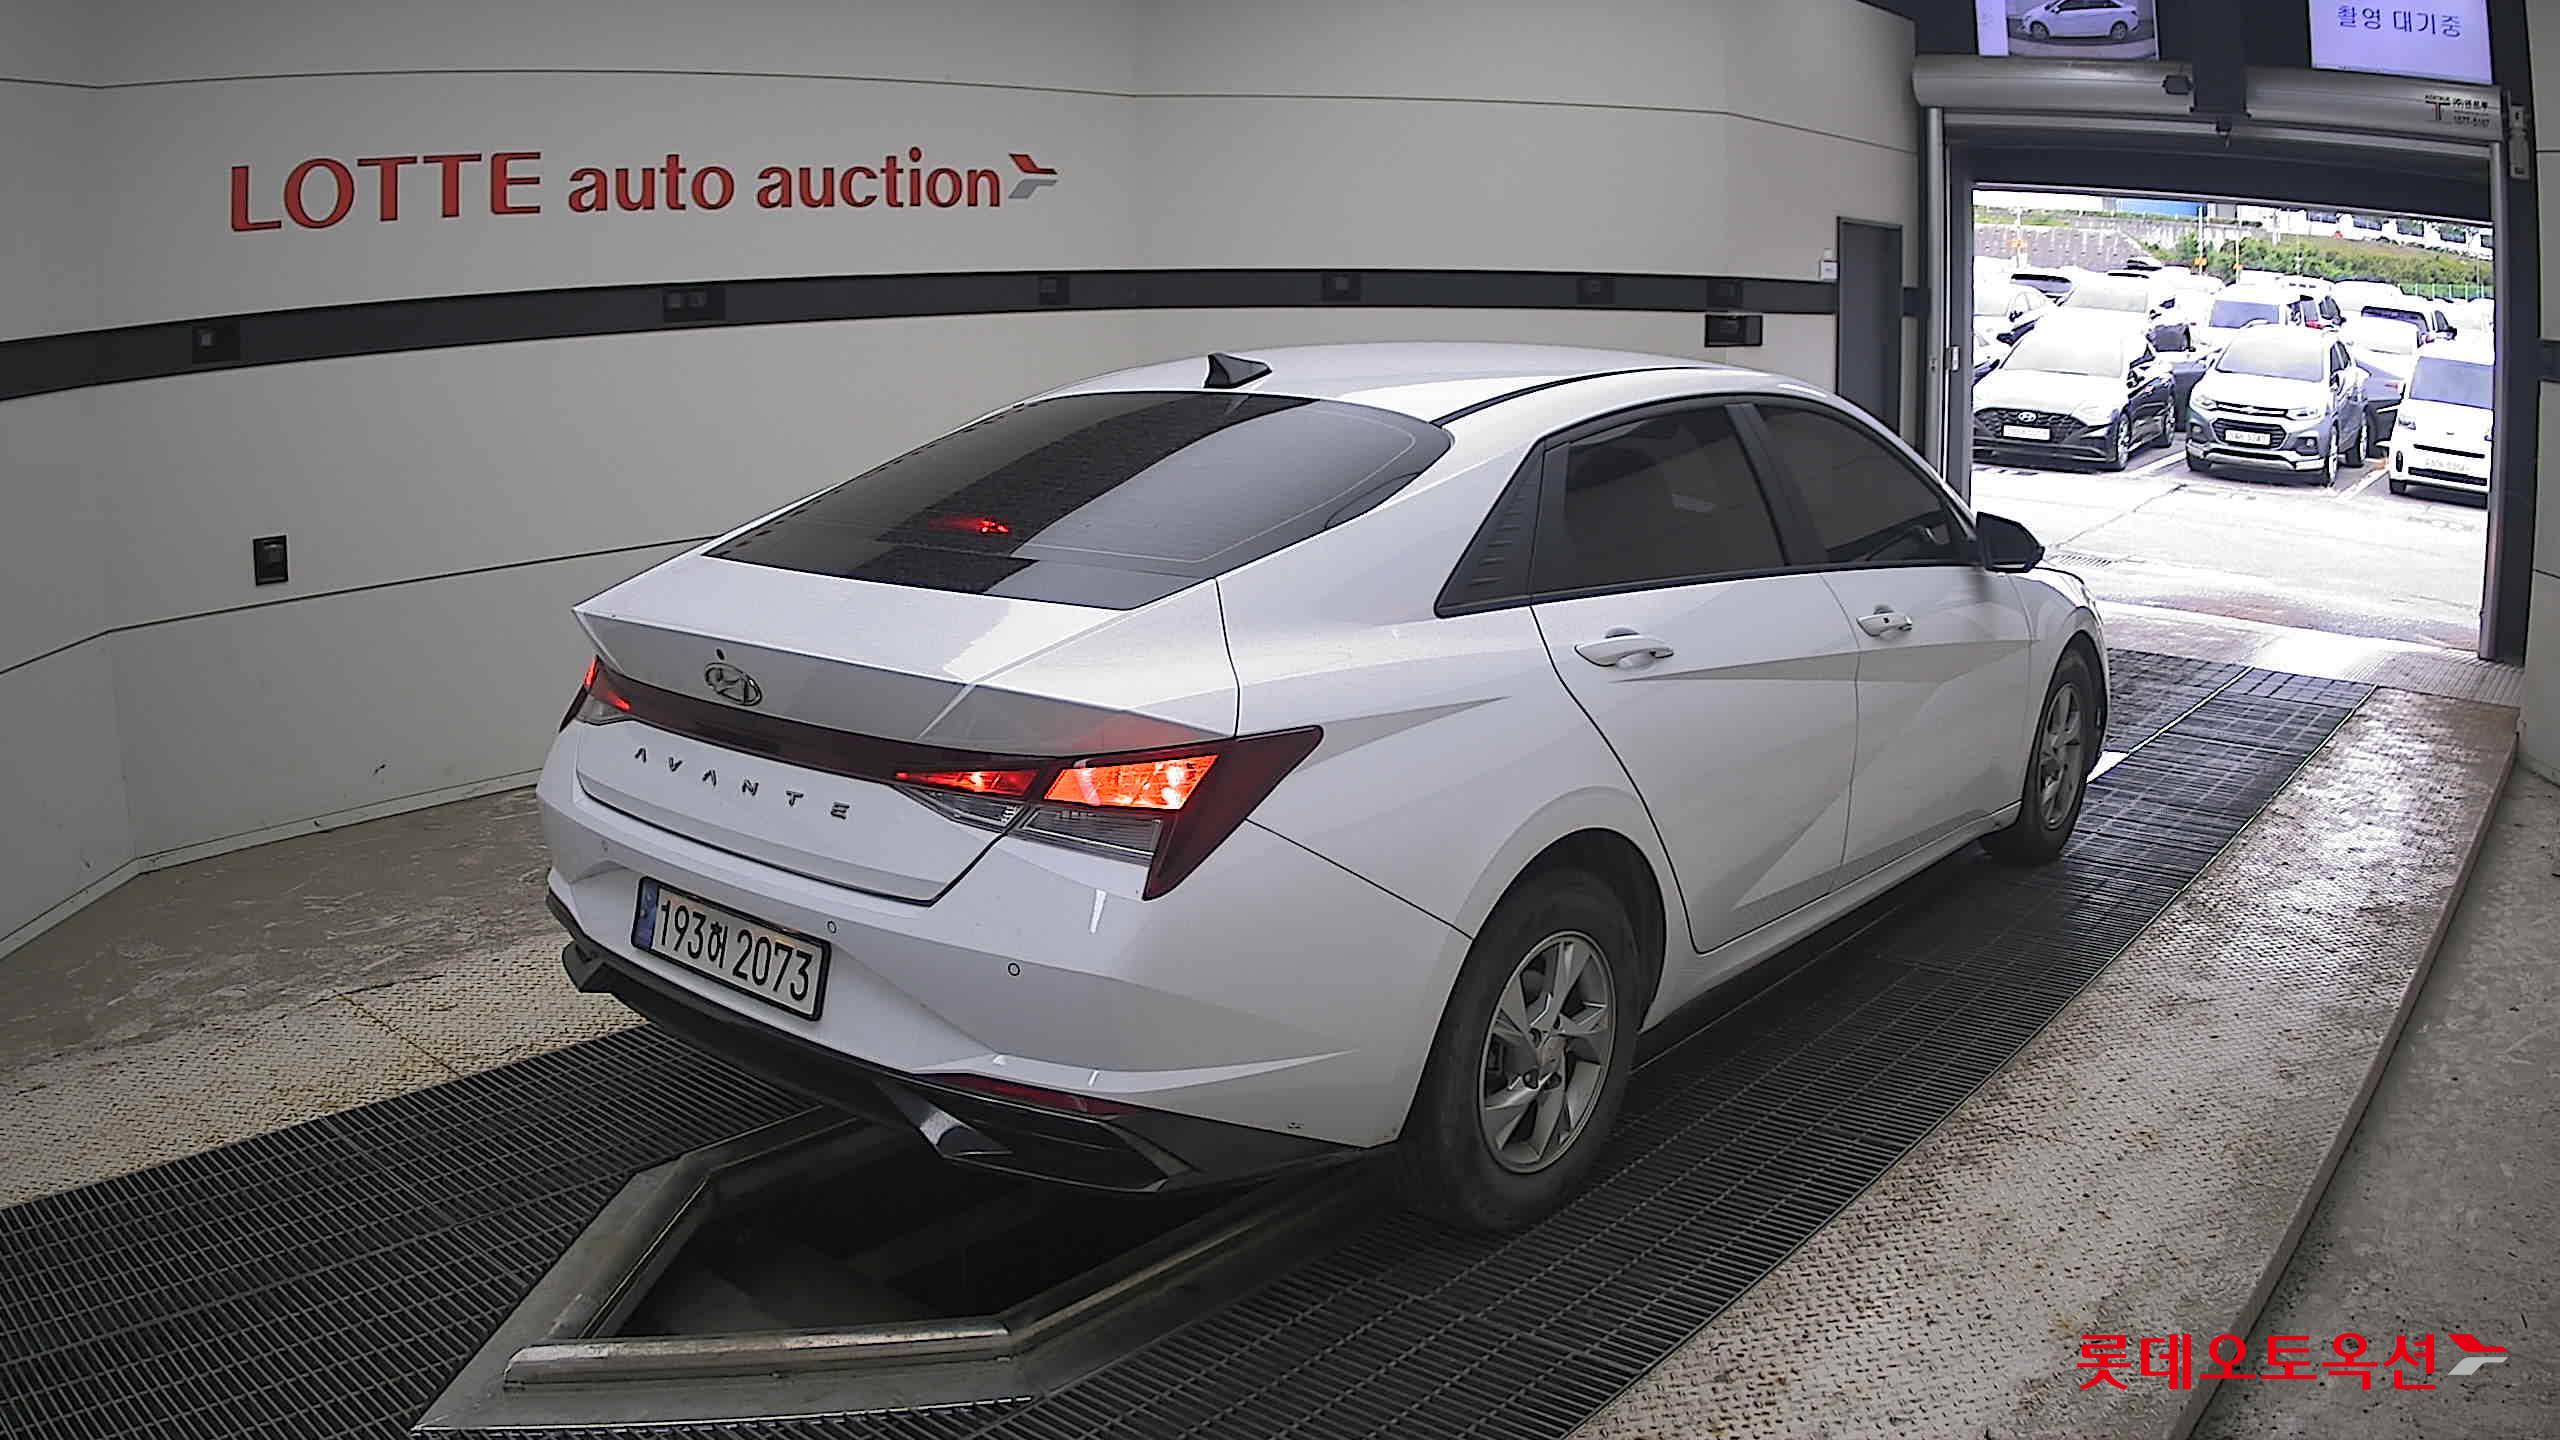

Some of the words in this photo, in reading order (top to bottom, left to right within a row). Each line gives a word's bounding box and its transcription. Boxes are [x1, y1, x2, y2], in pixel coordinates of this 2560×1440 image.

[2337, 5, 2382, 30] 촬영
[2392, 9, 2461, 38] 대기중
[231, 152, 541, 232] LOTTE
[568, 153, 735, 213] auto
[757, 147, 1003, 210] auction
[634, 747, 851, 820] AVANTE
[661, 900, 729, 970] 193허
[732, 929, 814, 1002] 2073
